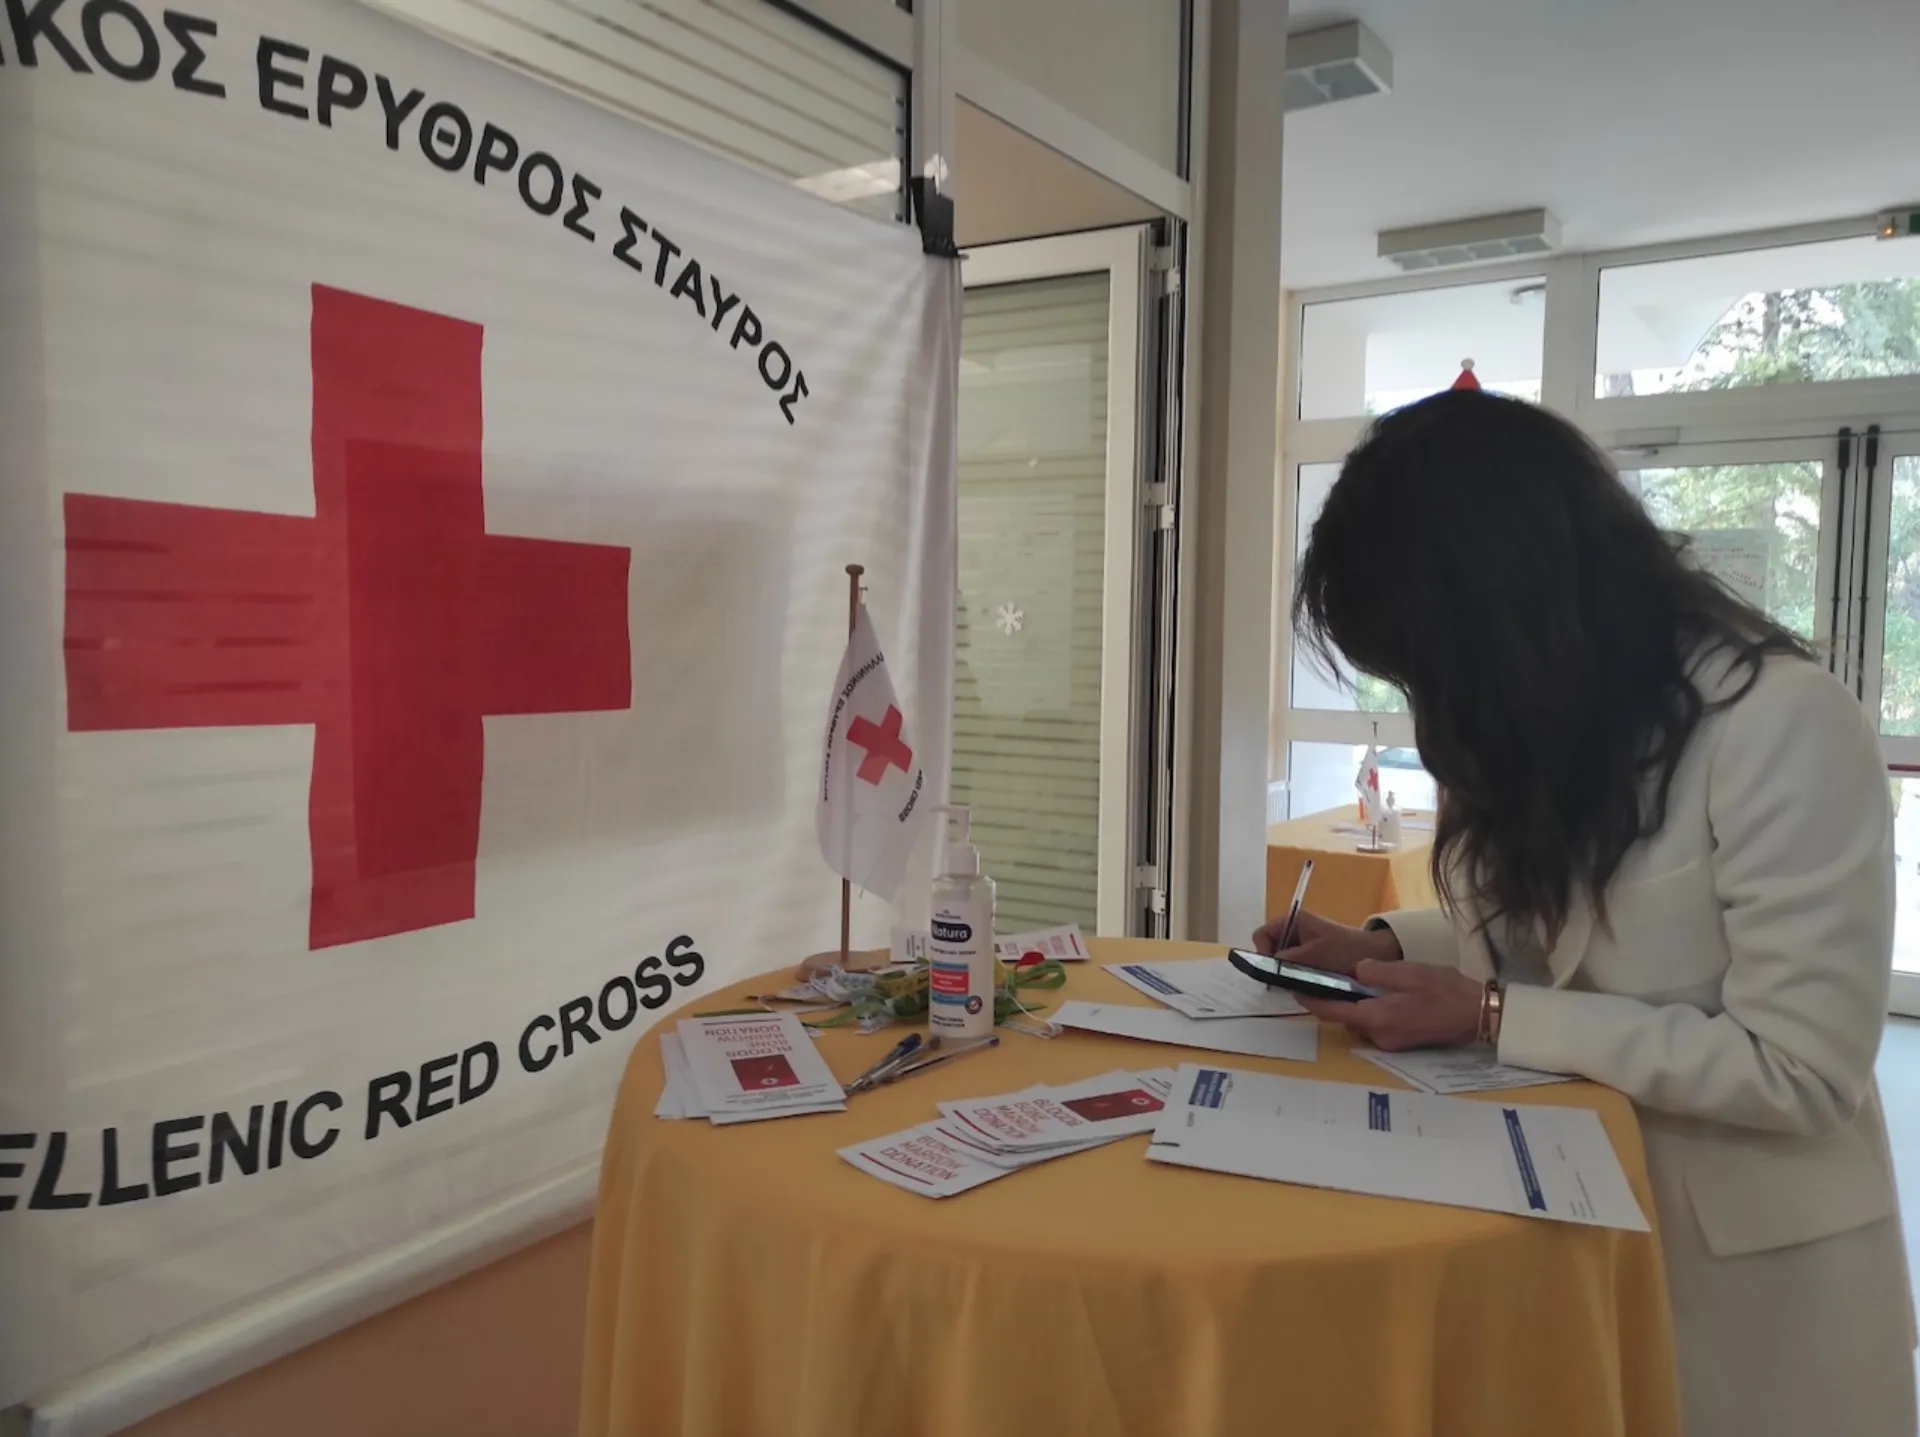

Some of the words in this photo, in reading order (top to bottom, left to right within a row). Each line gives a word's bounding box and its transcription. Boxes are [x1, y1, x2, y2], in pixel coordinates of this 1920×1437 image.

[0, 0, 226, 98] ΚΟΣ
[256, 36, 602, 242] ΕΡΥΘΡΟΣ
[612, 206, 809, 425] ΣΤΑΥΡΟΣ
[364, 1041, 499, 1140] RED
[518, 935, 705, 1073] CROSS
[880, 1147, 958, 1180] DONATION
